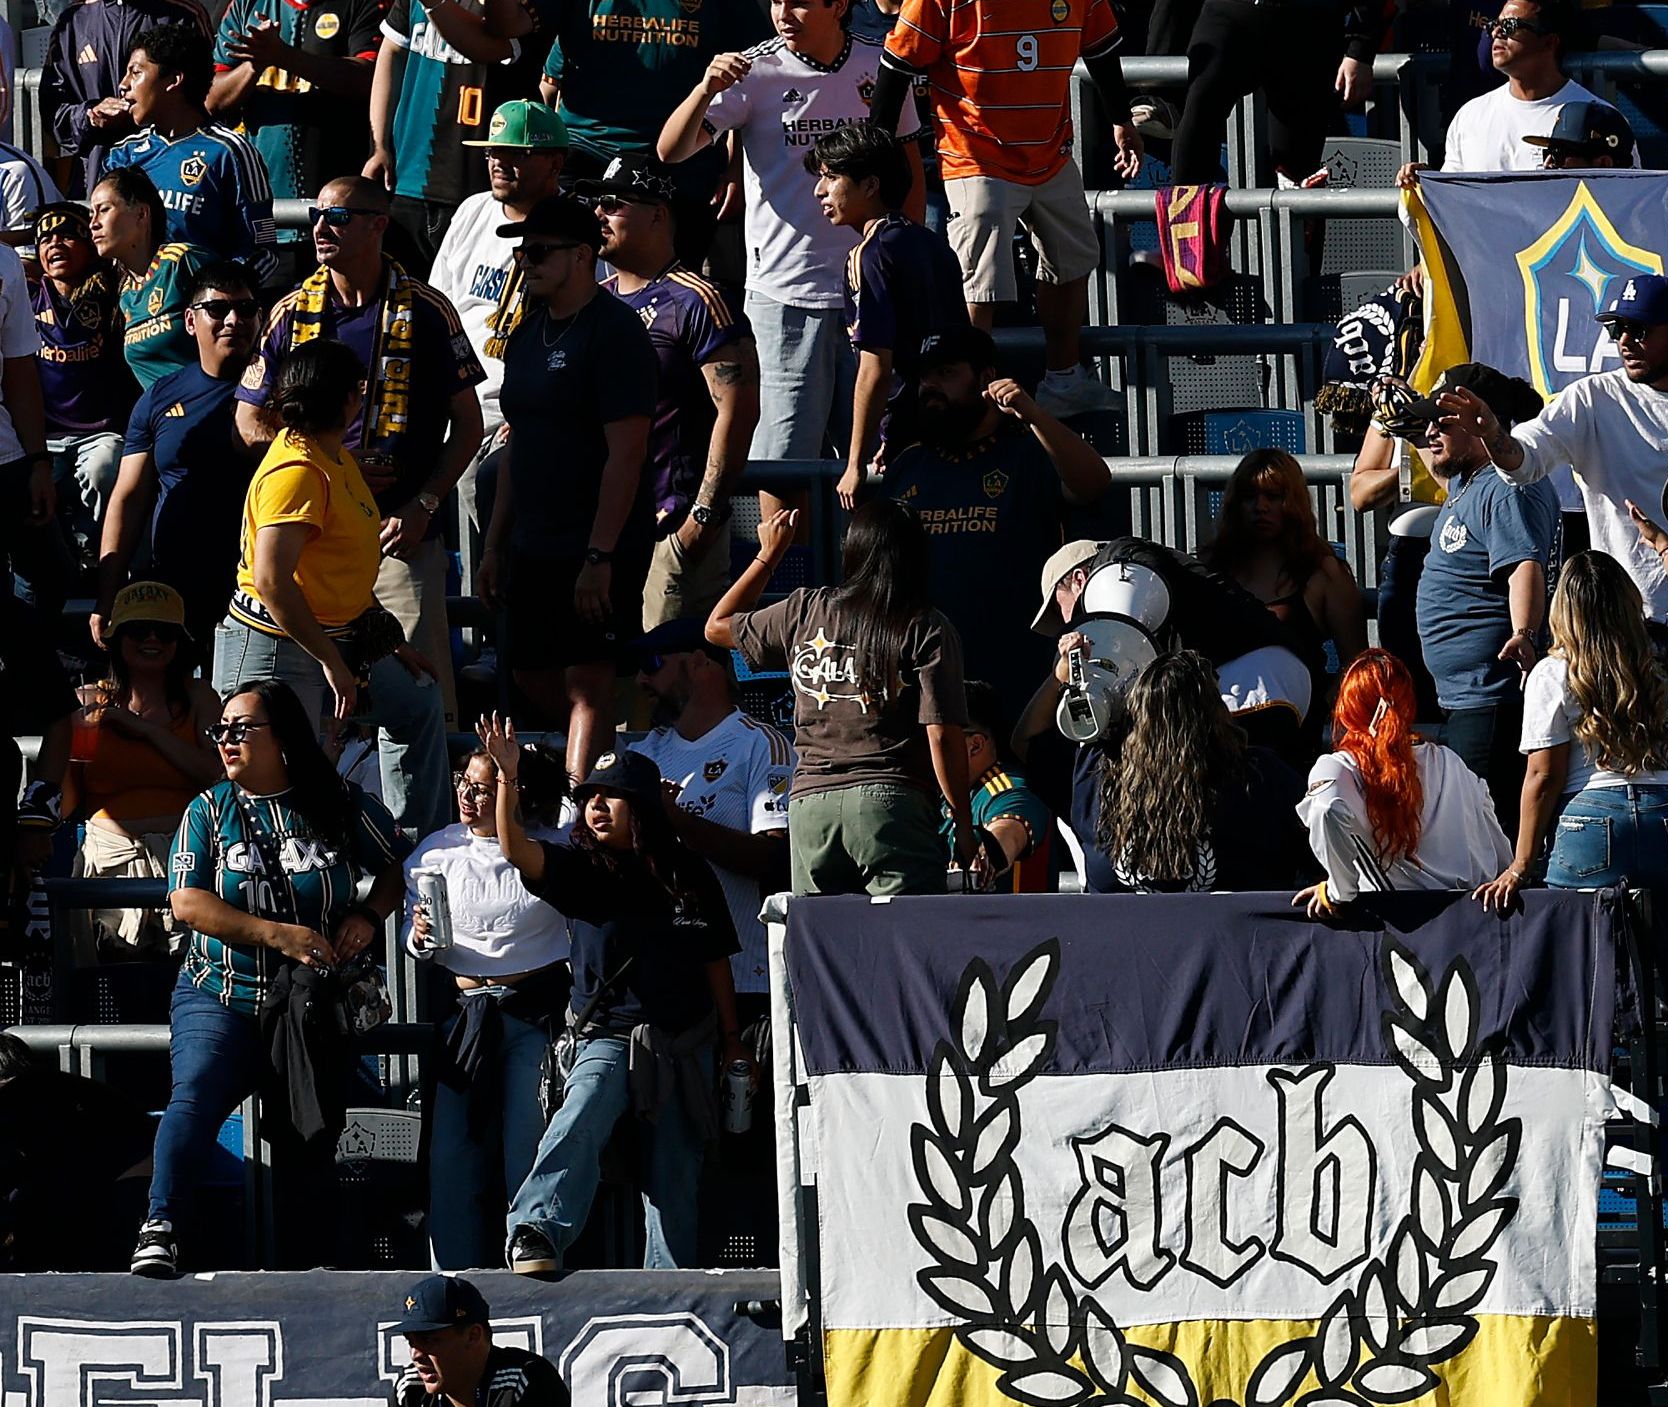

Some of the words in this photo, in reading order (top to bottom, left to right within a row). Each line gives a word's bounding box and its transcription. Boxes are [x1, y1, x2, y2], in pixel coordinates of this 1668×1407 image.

[592, 13, 700, 32] HERBALIFE
[592, 27, 700, 48] NUTRITION
[1017, 36, 1039, 72] 9
[1062, 1064, 1377, 1291] acb
